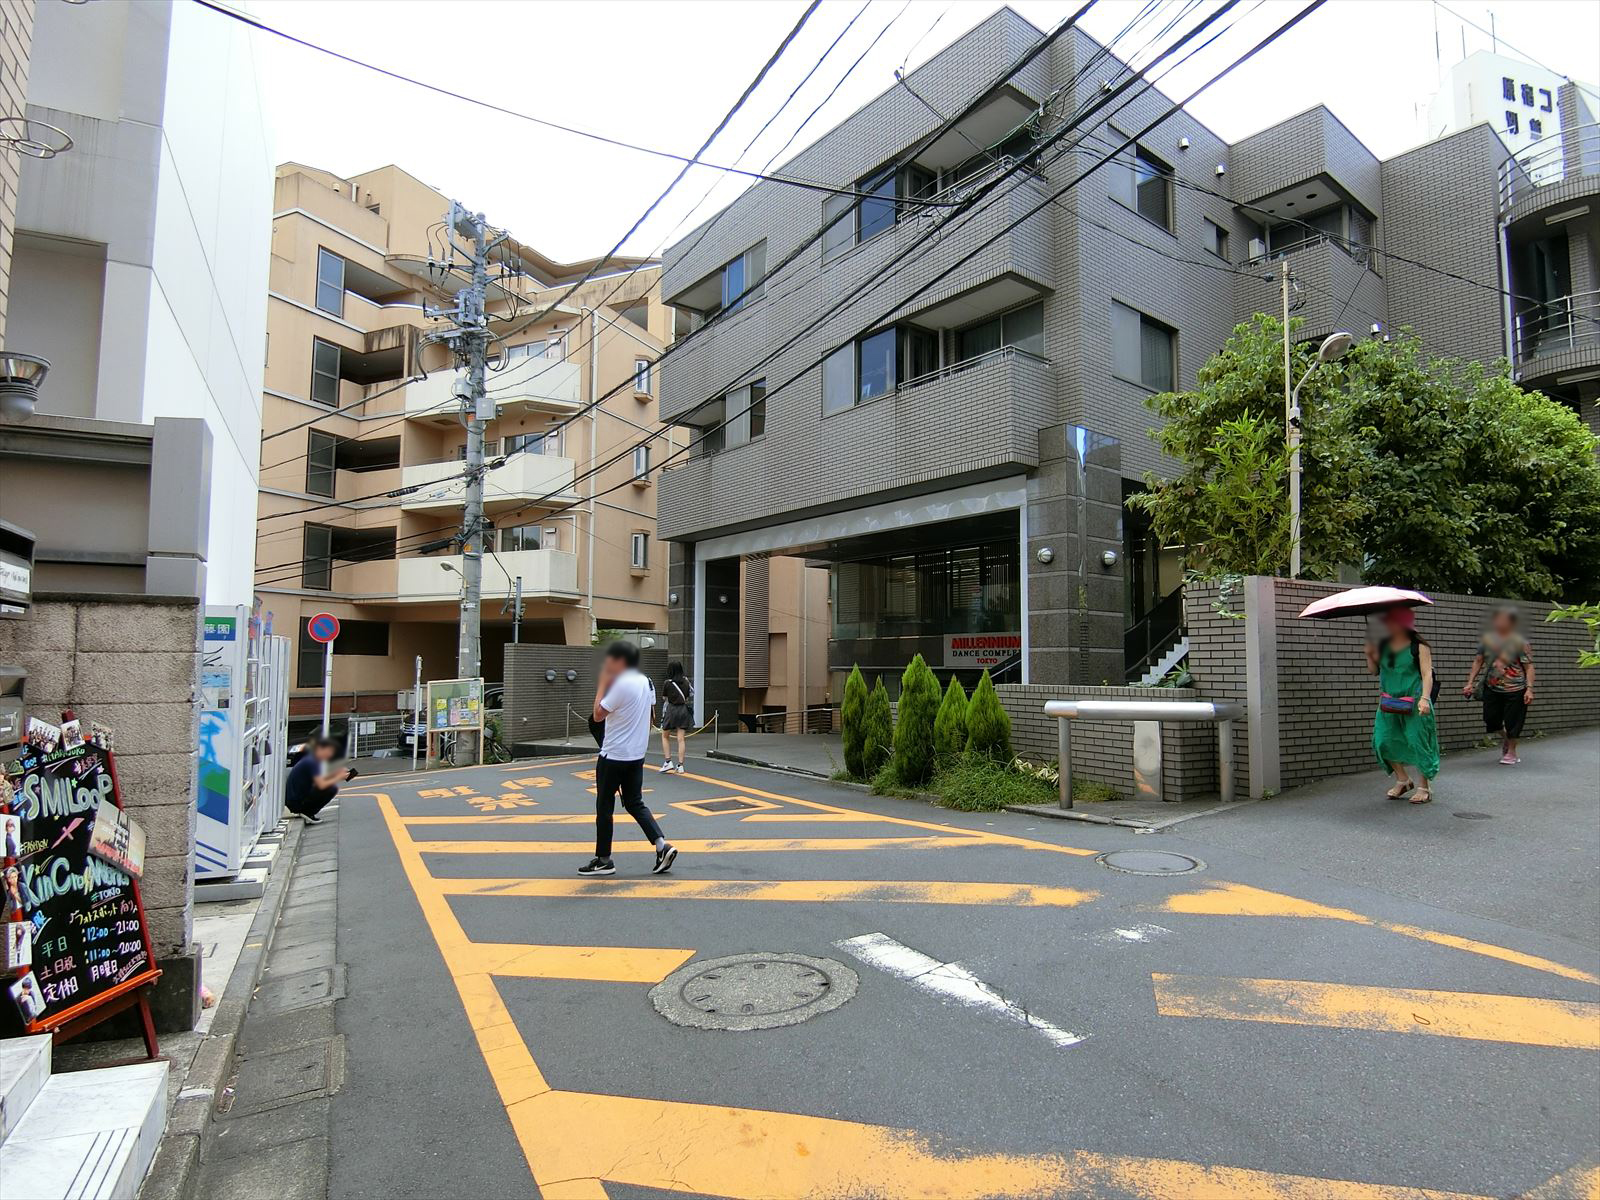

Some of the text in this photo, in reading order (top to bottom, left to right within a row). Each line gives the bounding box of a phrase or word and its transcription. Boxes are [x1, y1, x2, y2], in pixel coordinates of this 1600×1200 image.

[1502, 76, 1560, 113] 原宿コ
[982, 649, 1021, 657] COMPLE
[41, 936, 68, 957] 平日
[40, 955, 77, 980] 土日祝
[43, 976, 79, 1002] 定休日
[91, 960, 118, 982] 月曜日
